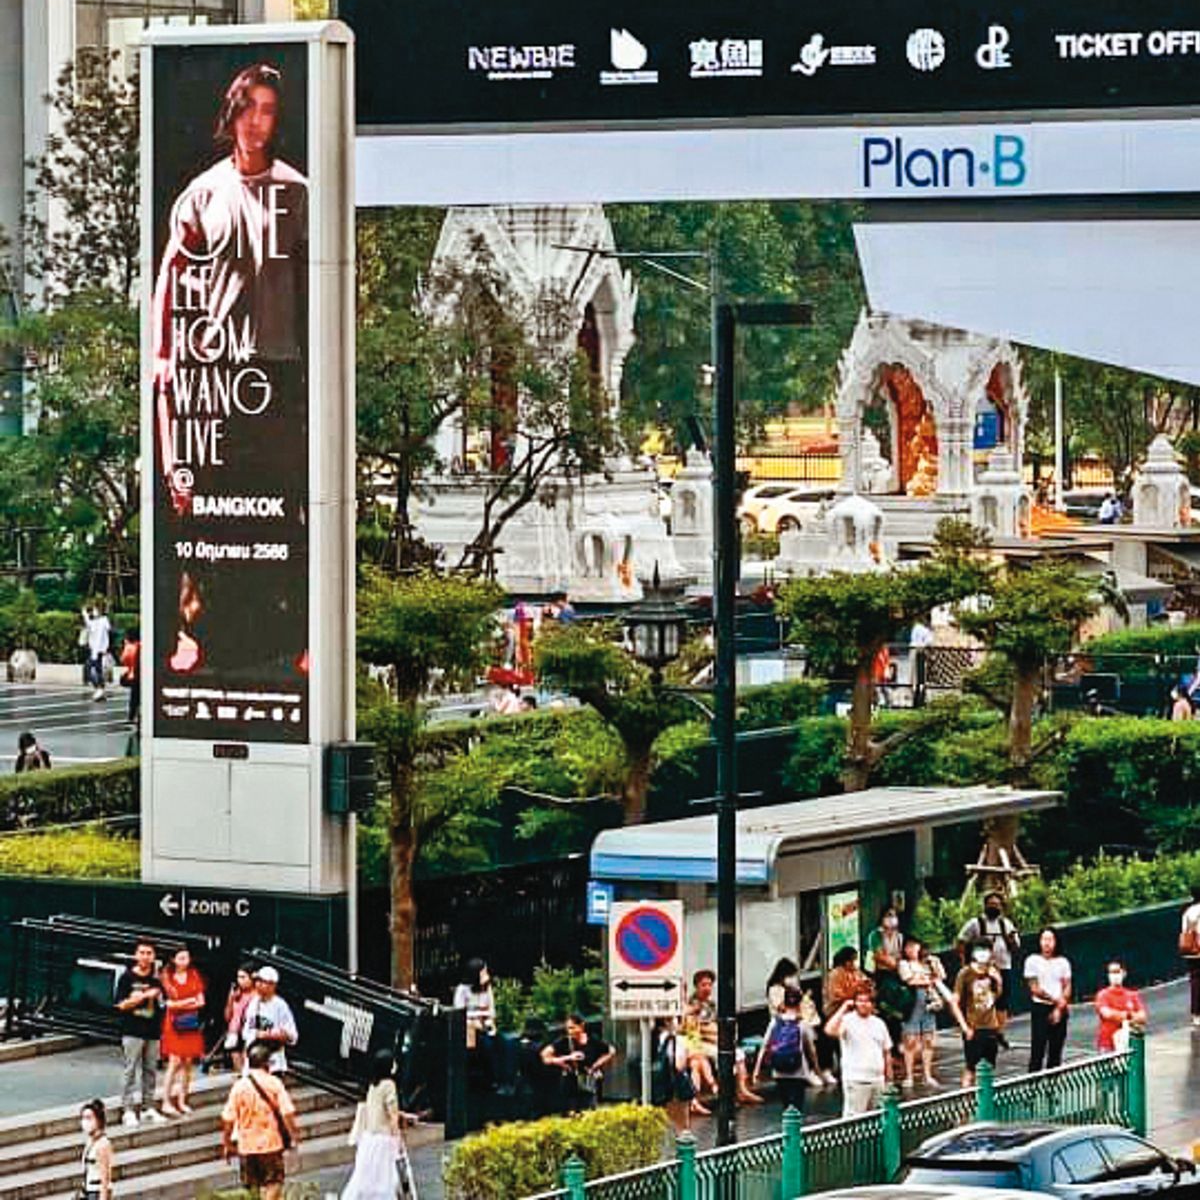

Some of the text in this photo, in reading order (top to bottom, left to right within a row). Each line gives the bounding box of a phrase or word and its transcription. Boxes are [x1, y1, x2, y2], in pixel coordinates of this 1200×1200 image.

[1055, 32, 1143, 58] TICKET
[170, 184, 289, 275] ONE
[172, 316, 252, 363] HOM
[172, 367, 271, 417] WANG
[172, 419, 224, 466] LIVE
[173, 468, 194, 492] @
[193, 495, 285, 517] BANGKOK
[175, 541, 193, 559] 10
[188, 898, 250, 917] zone C
